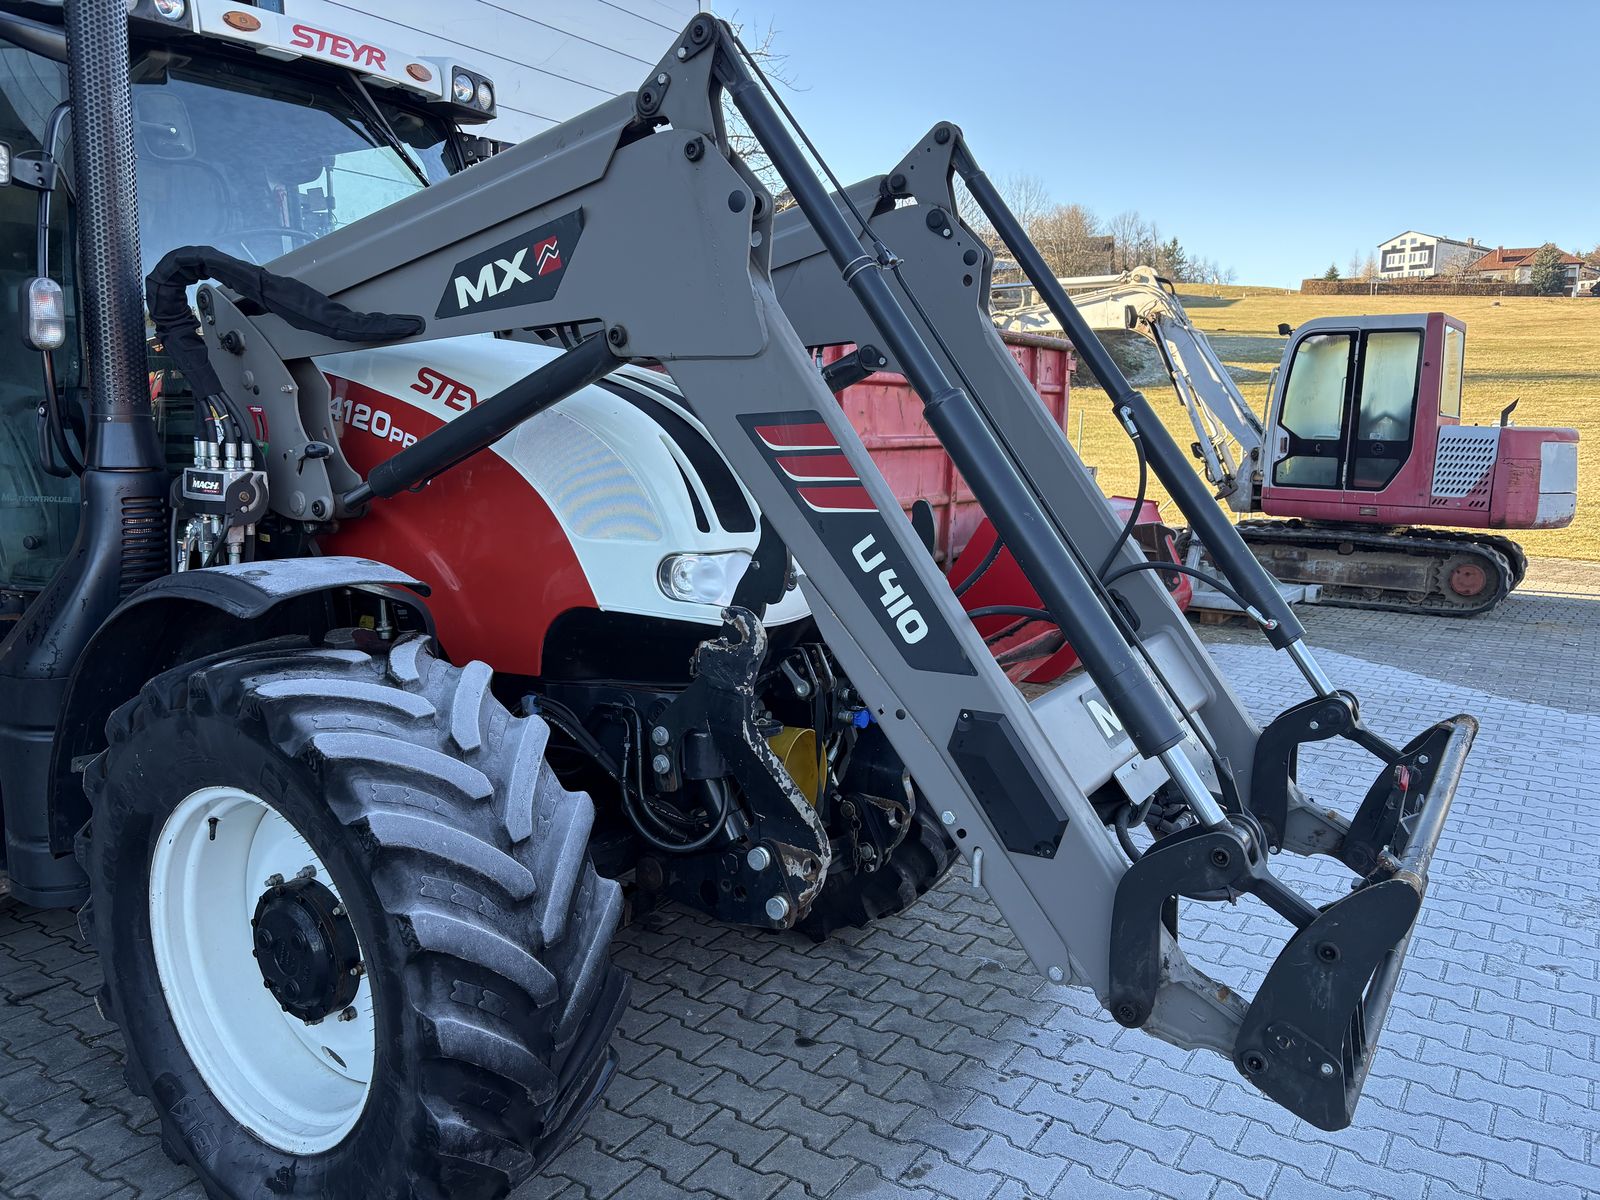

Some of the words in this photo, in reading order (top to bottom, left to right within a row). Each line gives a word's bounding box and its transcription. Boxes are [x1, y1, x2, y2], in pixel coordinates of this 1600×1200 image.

[289, 24, 387, 71] STEYR
[454, 247, 533, 309] MX
[852, 533, 887, 573] U
[878, 568, 929, 645] 410
